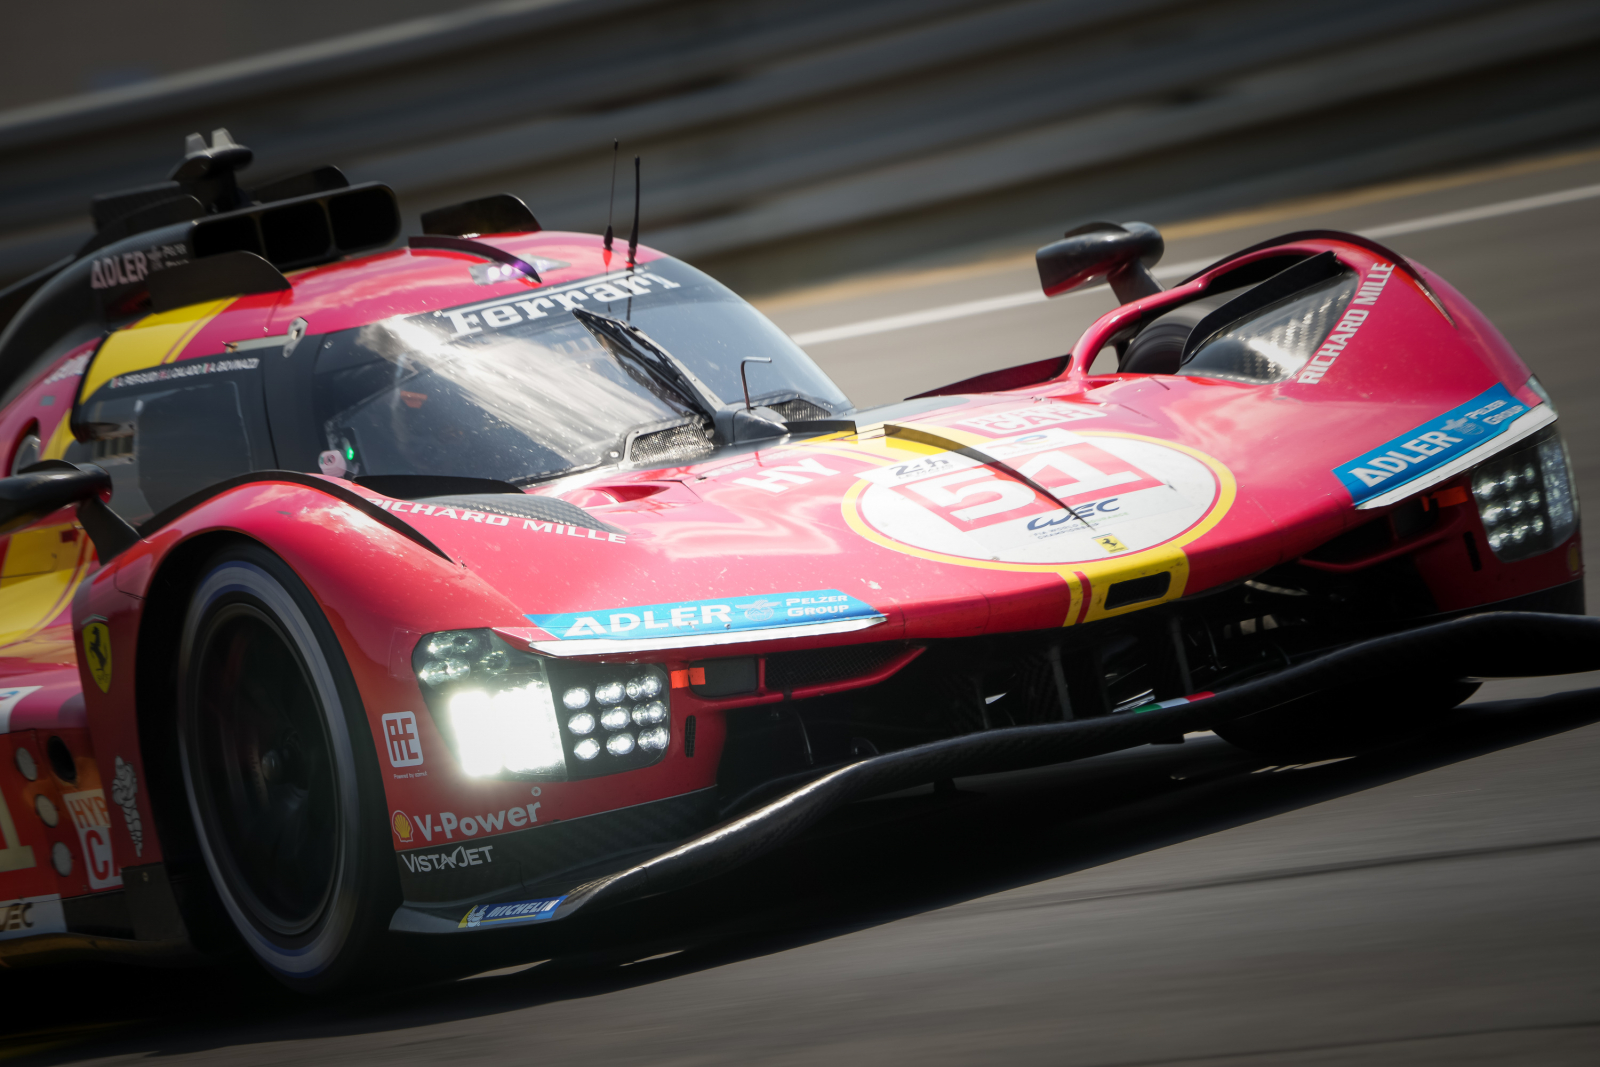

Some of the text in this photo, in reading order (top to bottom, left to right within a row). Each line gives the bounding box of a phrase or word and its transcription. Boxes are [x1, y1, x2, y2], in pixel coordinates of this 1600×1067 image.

[90, 250, 149, 290] ADLER
[437, 267, 682, 339] Ferrari
[1296, 262, 1396, 385] RICHARD MILLE
[985, 409, 1095, 431] CAR
[1465, 399, 1508, 420] PELZER
[1482, 404, 1526, 426] GROUP
[731, 457, 842, 493] HY
[1347, 430, 1464, 488] ADLER
[905, 449, 1143, 523] 51
[1026, 497, 1121, 531] WEC
[522, 519, 627, 545] MILLE
[785, 595, 848, 607] PELZER
[787, 604, 849, 617] GROUP
[563, 604, 733, 638] ADLER
[412, 801, 542, 842] V-Power
[86, 830, 122, 881] C
[485, 899, 560, 918] MICHELIN
